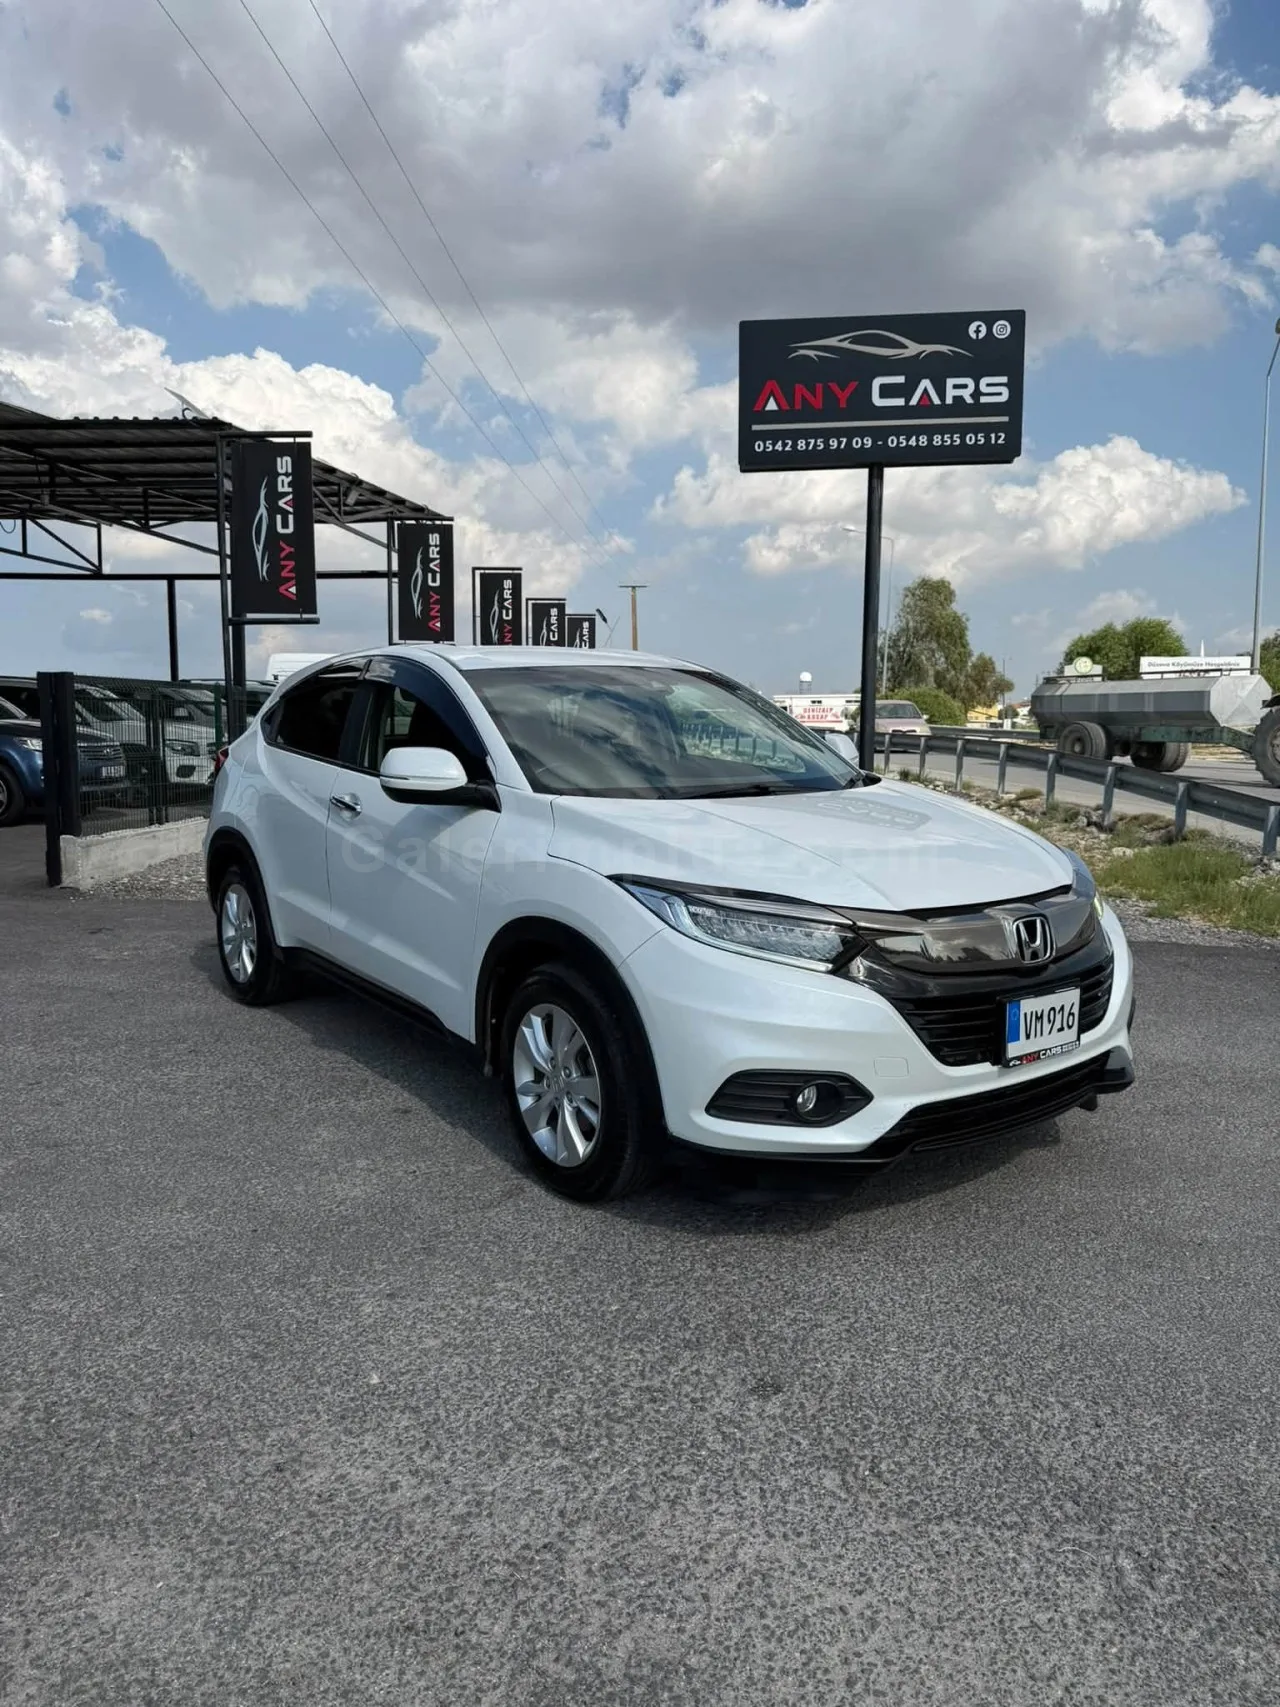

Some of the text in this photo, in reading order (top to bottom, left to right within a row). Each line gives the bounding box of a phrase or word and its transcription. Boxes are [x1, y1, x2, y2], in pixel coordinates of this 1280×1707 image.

[753, 375, 1010, 411] ANY CARS
[754, 440, 792, 452] 0542
[797, 439, 825, 450] 875
[829, 438, 847, 449] 97
[852, 437, 872, 448] 09
[888, 435, 928, 447] 0548
[933, 434, 961, 446] 855
[966, 433, 985, 445] 05
[989, 432, 1006, 444] 12
[276, 455, 297, 601] ANY CARS
[427, 532, 441, 632] ANY CARS
[502, 579, 513, 645] NY CARS
[549, 607, 558, 641] CARS
[1023, 1002, 1075, 1040] VM 916
[1040, 1046, 1062, 1059] CARS
